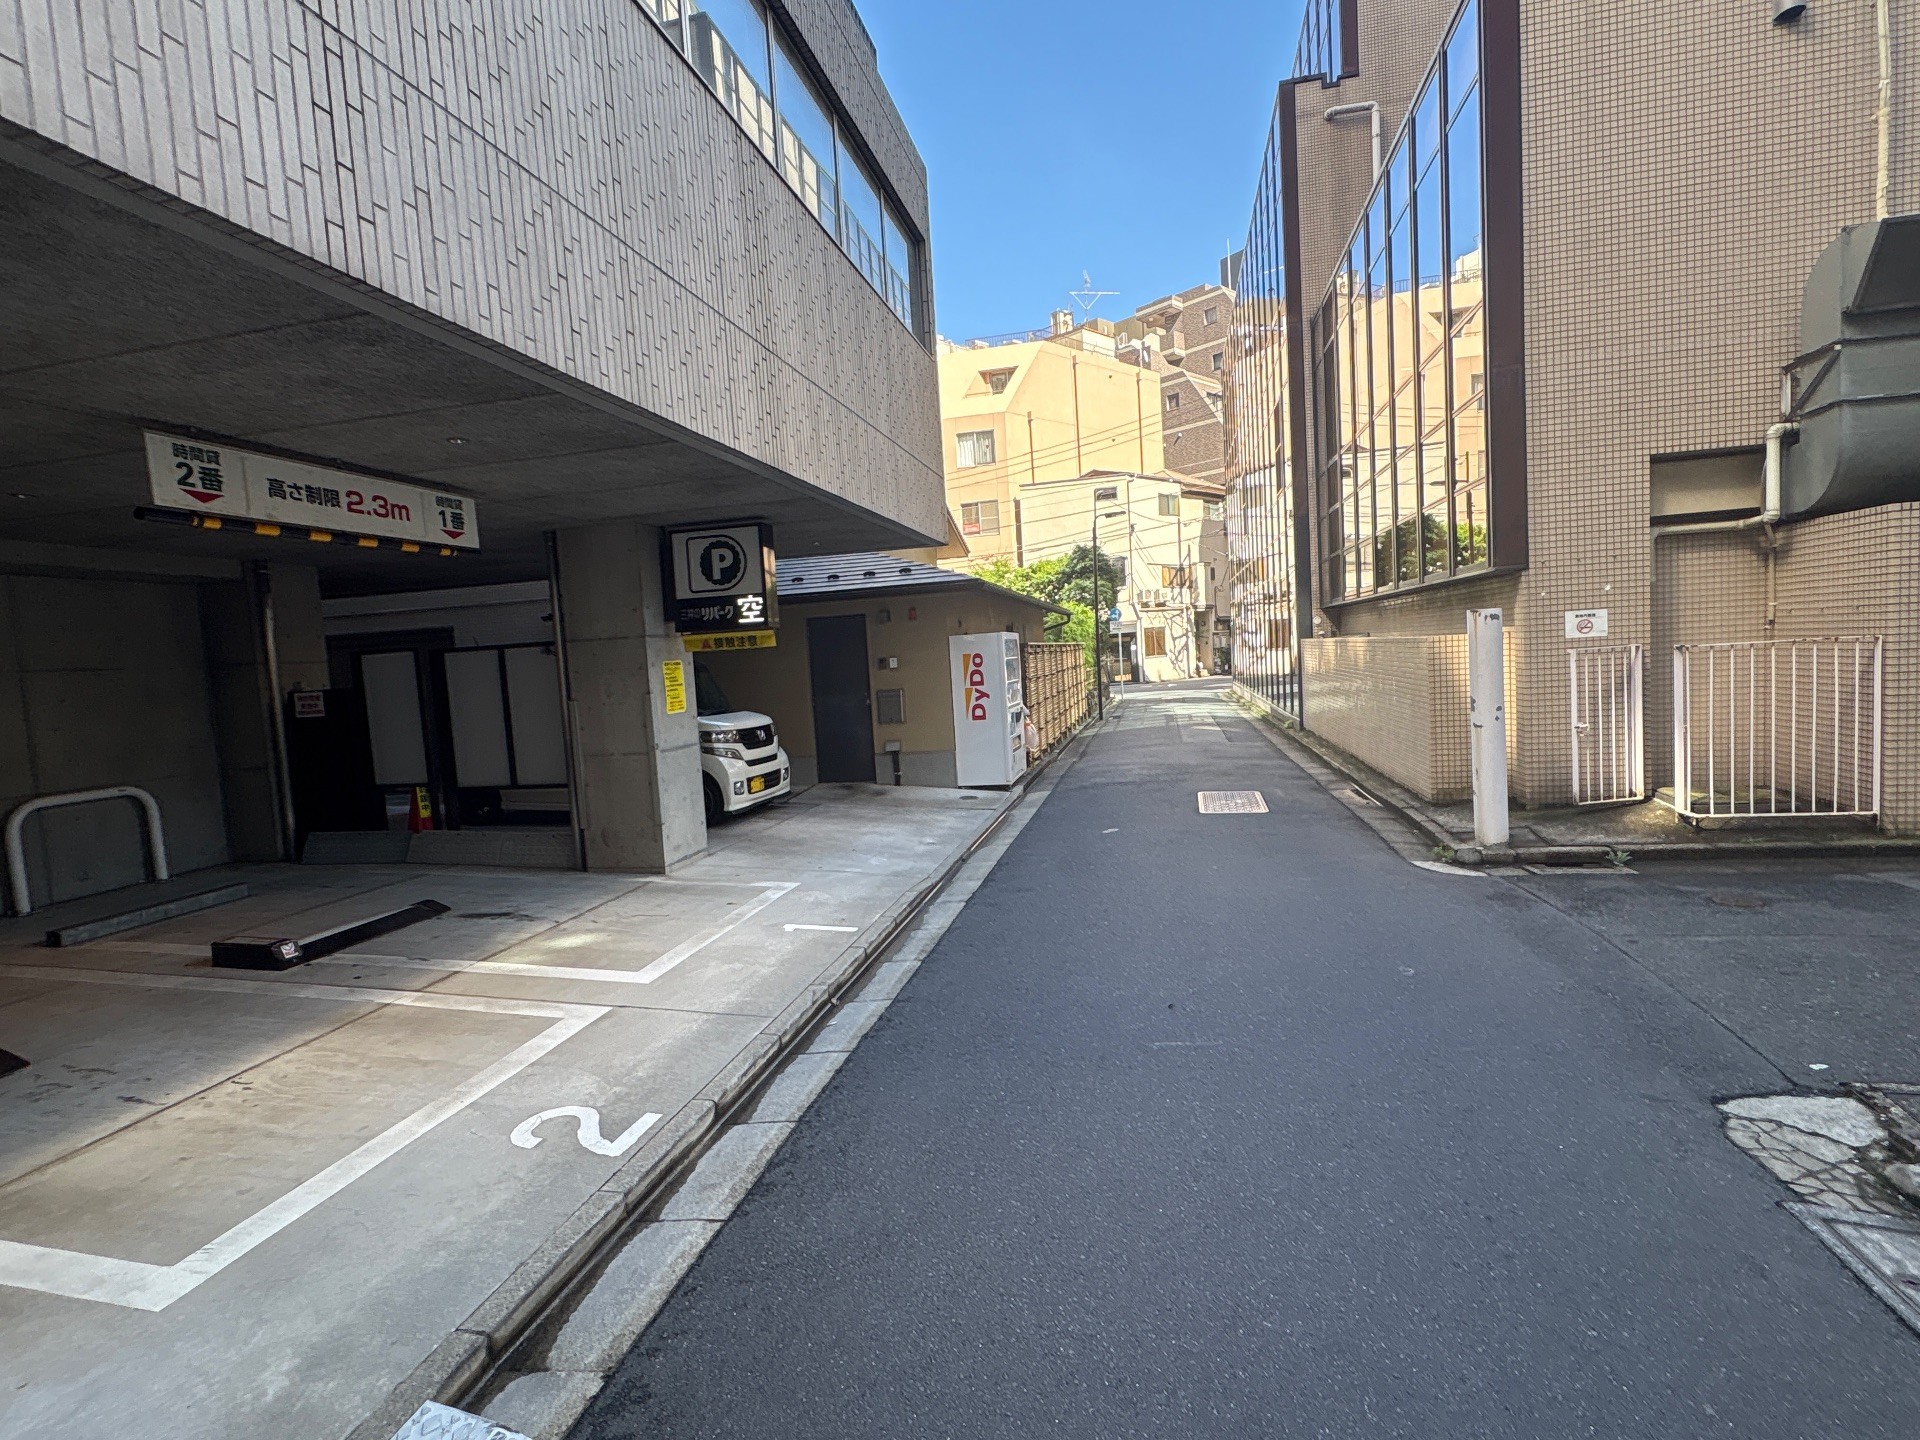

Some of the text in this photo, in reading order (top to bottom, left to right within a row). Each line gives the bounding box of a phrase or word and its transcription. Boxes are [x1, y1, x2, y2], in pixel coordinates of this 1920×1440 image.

[172, 442, 221, 467] 時間貸
[176, 461, 223, 492] 2番
[439, 509, 465, 531] 1番
[712, 548, 734, 580] P
[737, 594, 765, 623] 空
[969, 652, 991, 721] DyDo
[510, 1106, 663, 1157] 2
